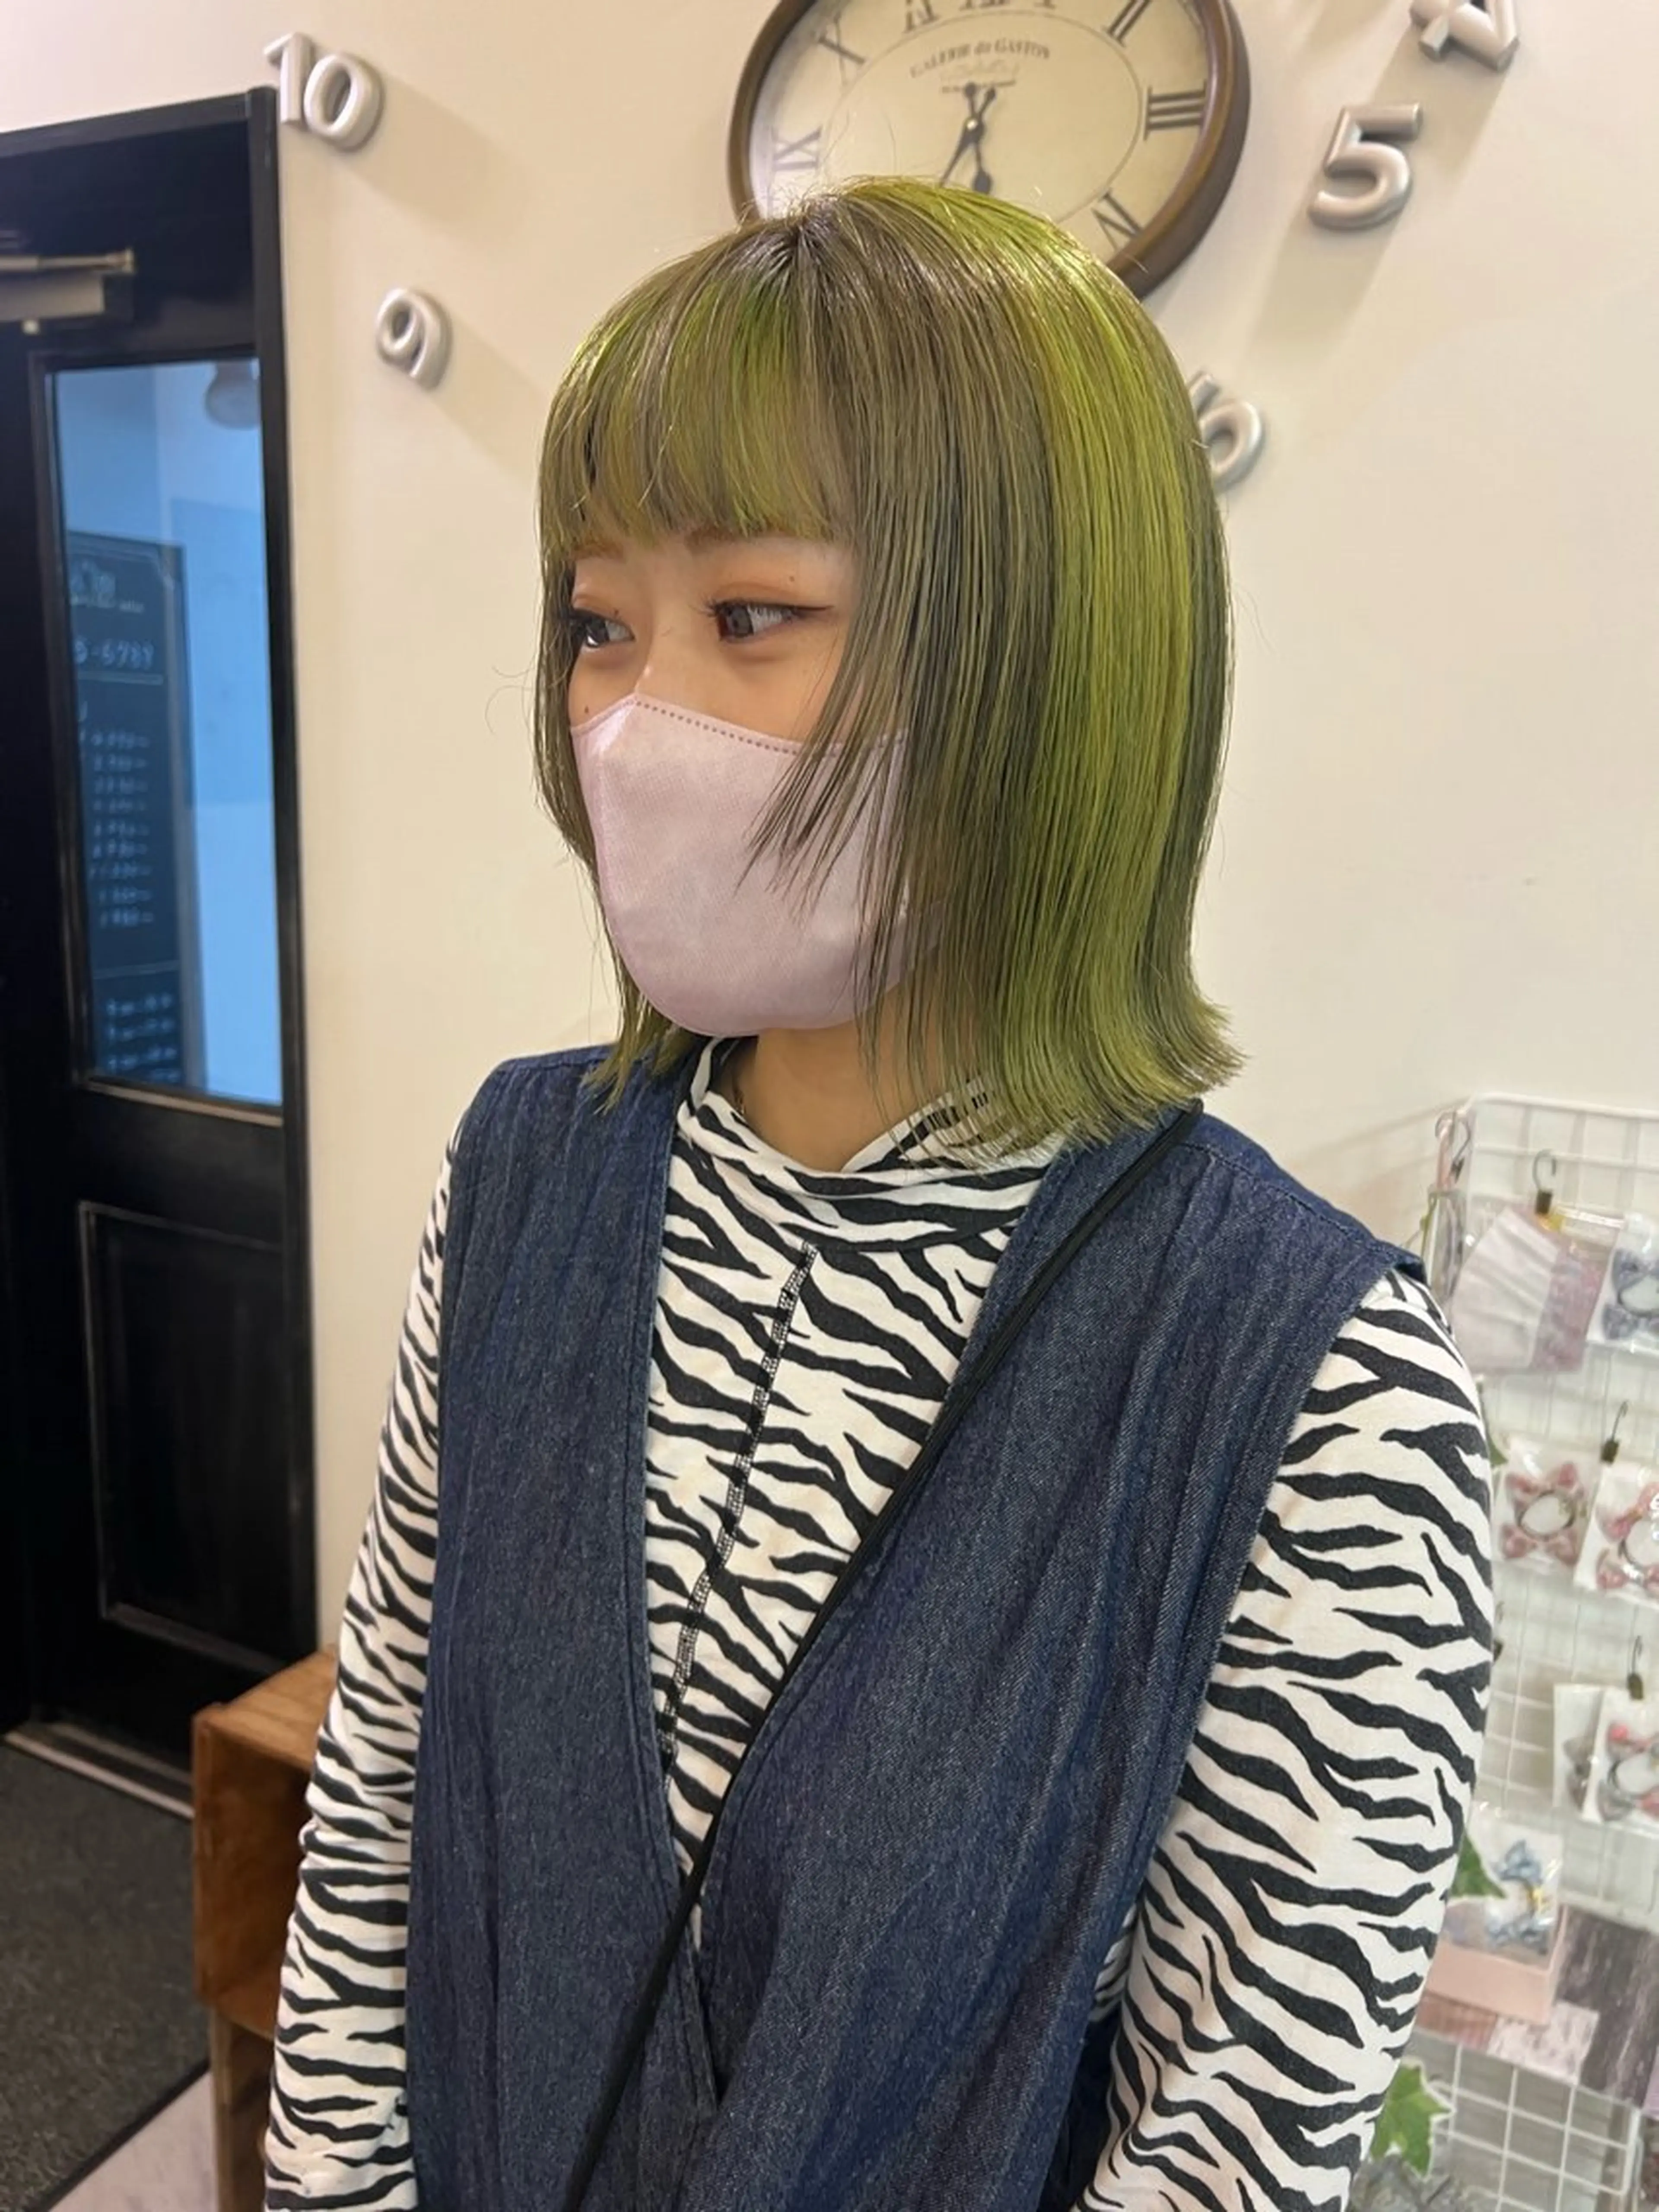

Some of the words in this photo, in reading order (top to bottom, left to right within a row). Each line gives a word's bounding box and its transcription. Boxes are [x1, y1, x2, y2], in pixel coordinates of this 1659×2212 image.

[263, 32, 384, 150] 10
[1307, 103, 1423, 232] 5
[374, 287, 451, 389] 9
